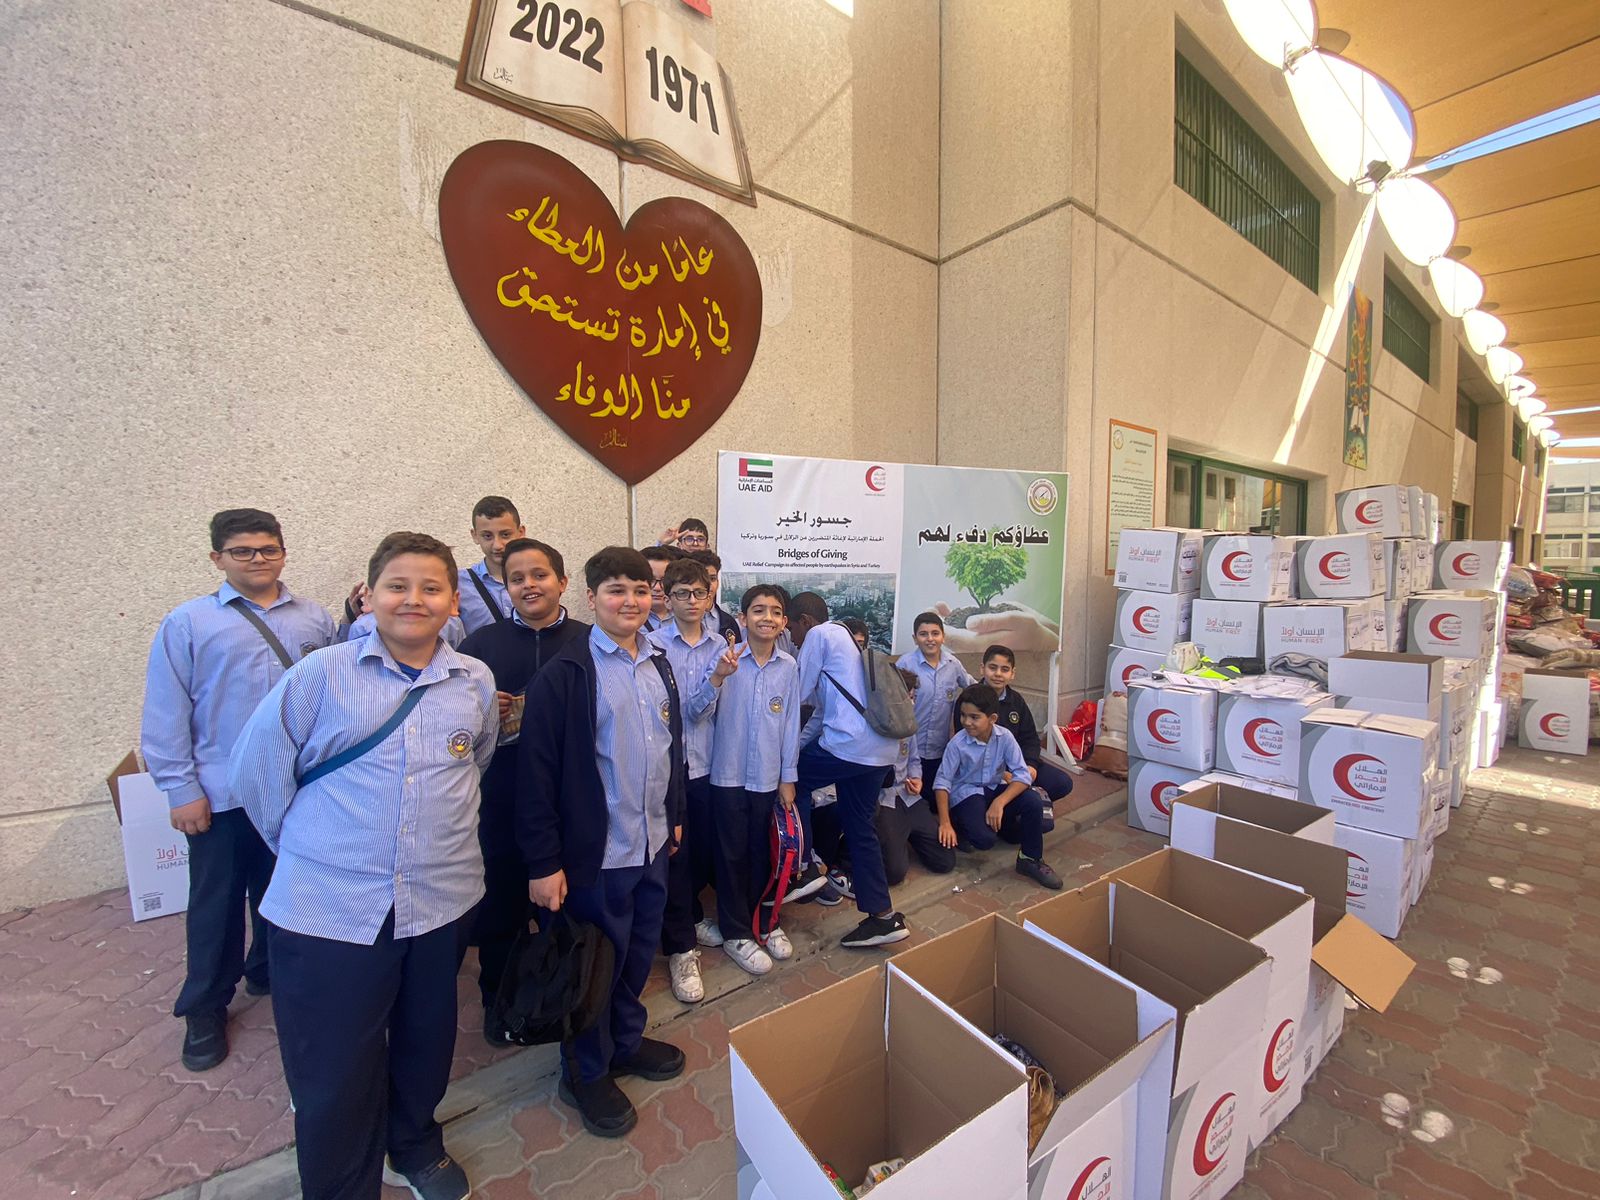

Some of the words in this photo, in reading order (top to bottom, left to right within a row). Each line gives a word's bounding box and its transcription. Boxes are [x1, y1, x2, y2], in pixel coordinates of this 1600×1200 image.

[509, 0, 605, 73] 2022
[646, 46, 719, 135] 1971
[507, 196, 605, 273] العطاء
[616, 249, 658, 290] من
[497, 267, 620, 342] تستحق
[630, 304, 702, 361] إمارة
[703, 296, 732, 355] في
[555, 361, 643, 420] الوفاء
[738, 483, 756, 492] UAE
[758, 484, 773, 493] AID
[776, 510, 807, 527] الخير
[810, 516, 852, 528] جسور
[741, 532, 757, 540] وتركيا
[775, 533, 783, 542] في
[919, 524, 951, 546] لهم
[956, 524, 987, 543] دفء
[993, 524, 1049, 547] عطاؤكم
[778, 548, 809, 561] Bridges
[810, 548, 820, 558] of
[820, 548, 848, 561] Giving
